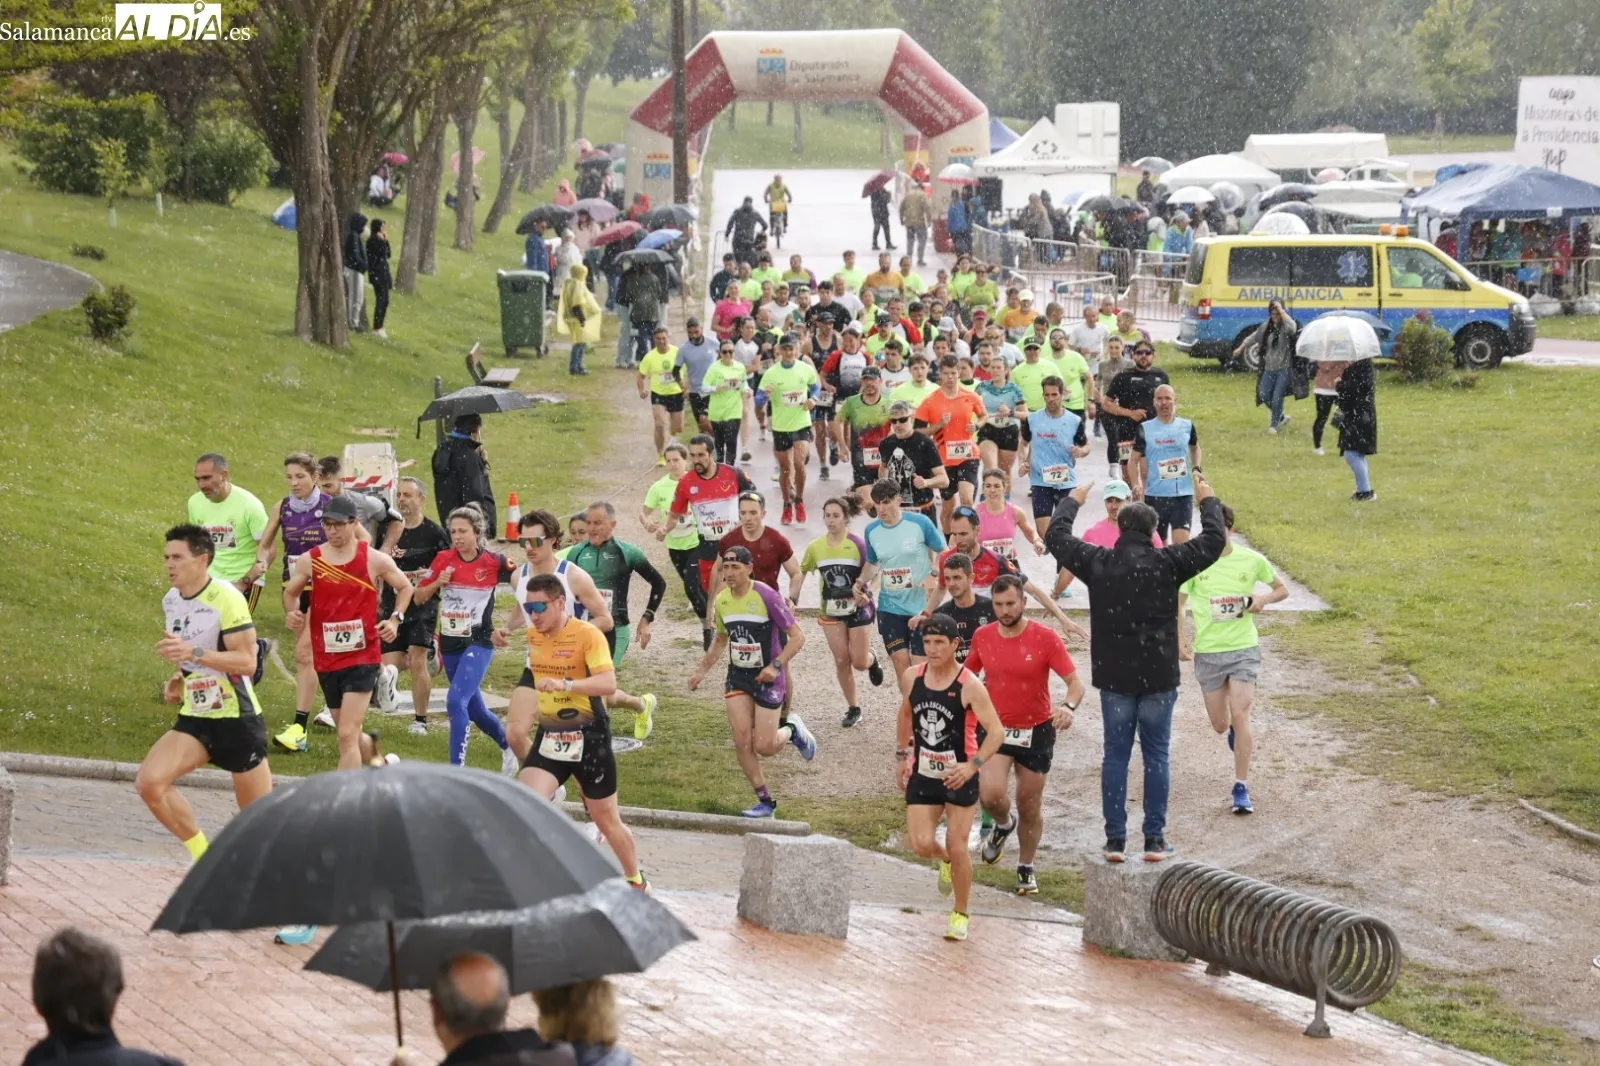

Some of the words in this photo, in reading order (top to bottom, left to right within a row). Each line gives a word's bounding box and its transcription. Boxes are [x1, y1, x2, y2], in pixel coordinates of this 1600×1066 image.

[804, 72, 860, 83] Salamanca
[1238, 288, 1343, 300] AMBULANCIA
[1051, 471, 1062, 479] 72
[712, 526, 723, 534] 10
[211, 532, 224, 543] 57
[890, 575, 904, 584] 33
[835, 600, 848, 609] 98
[1220, 603, 1235, 614] 32
[450, 618, 456, 629] 5
[335, 631, 351, 643] 49
[739, 651, 752, 661] 27
[192, 689, 206, 704] 85
[1005, 729, 1019, 739] 70
[459, 725, 470, 767] didas
[554, 741, 570, 753] 37
[929, 760, 944, 771] 50
